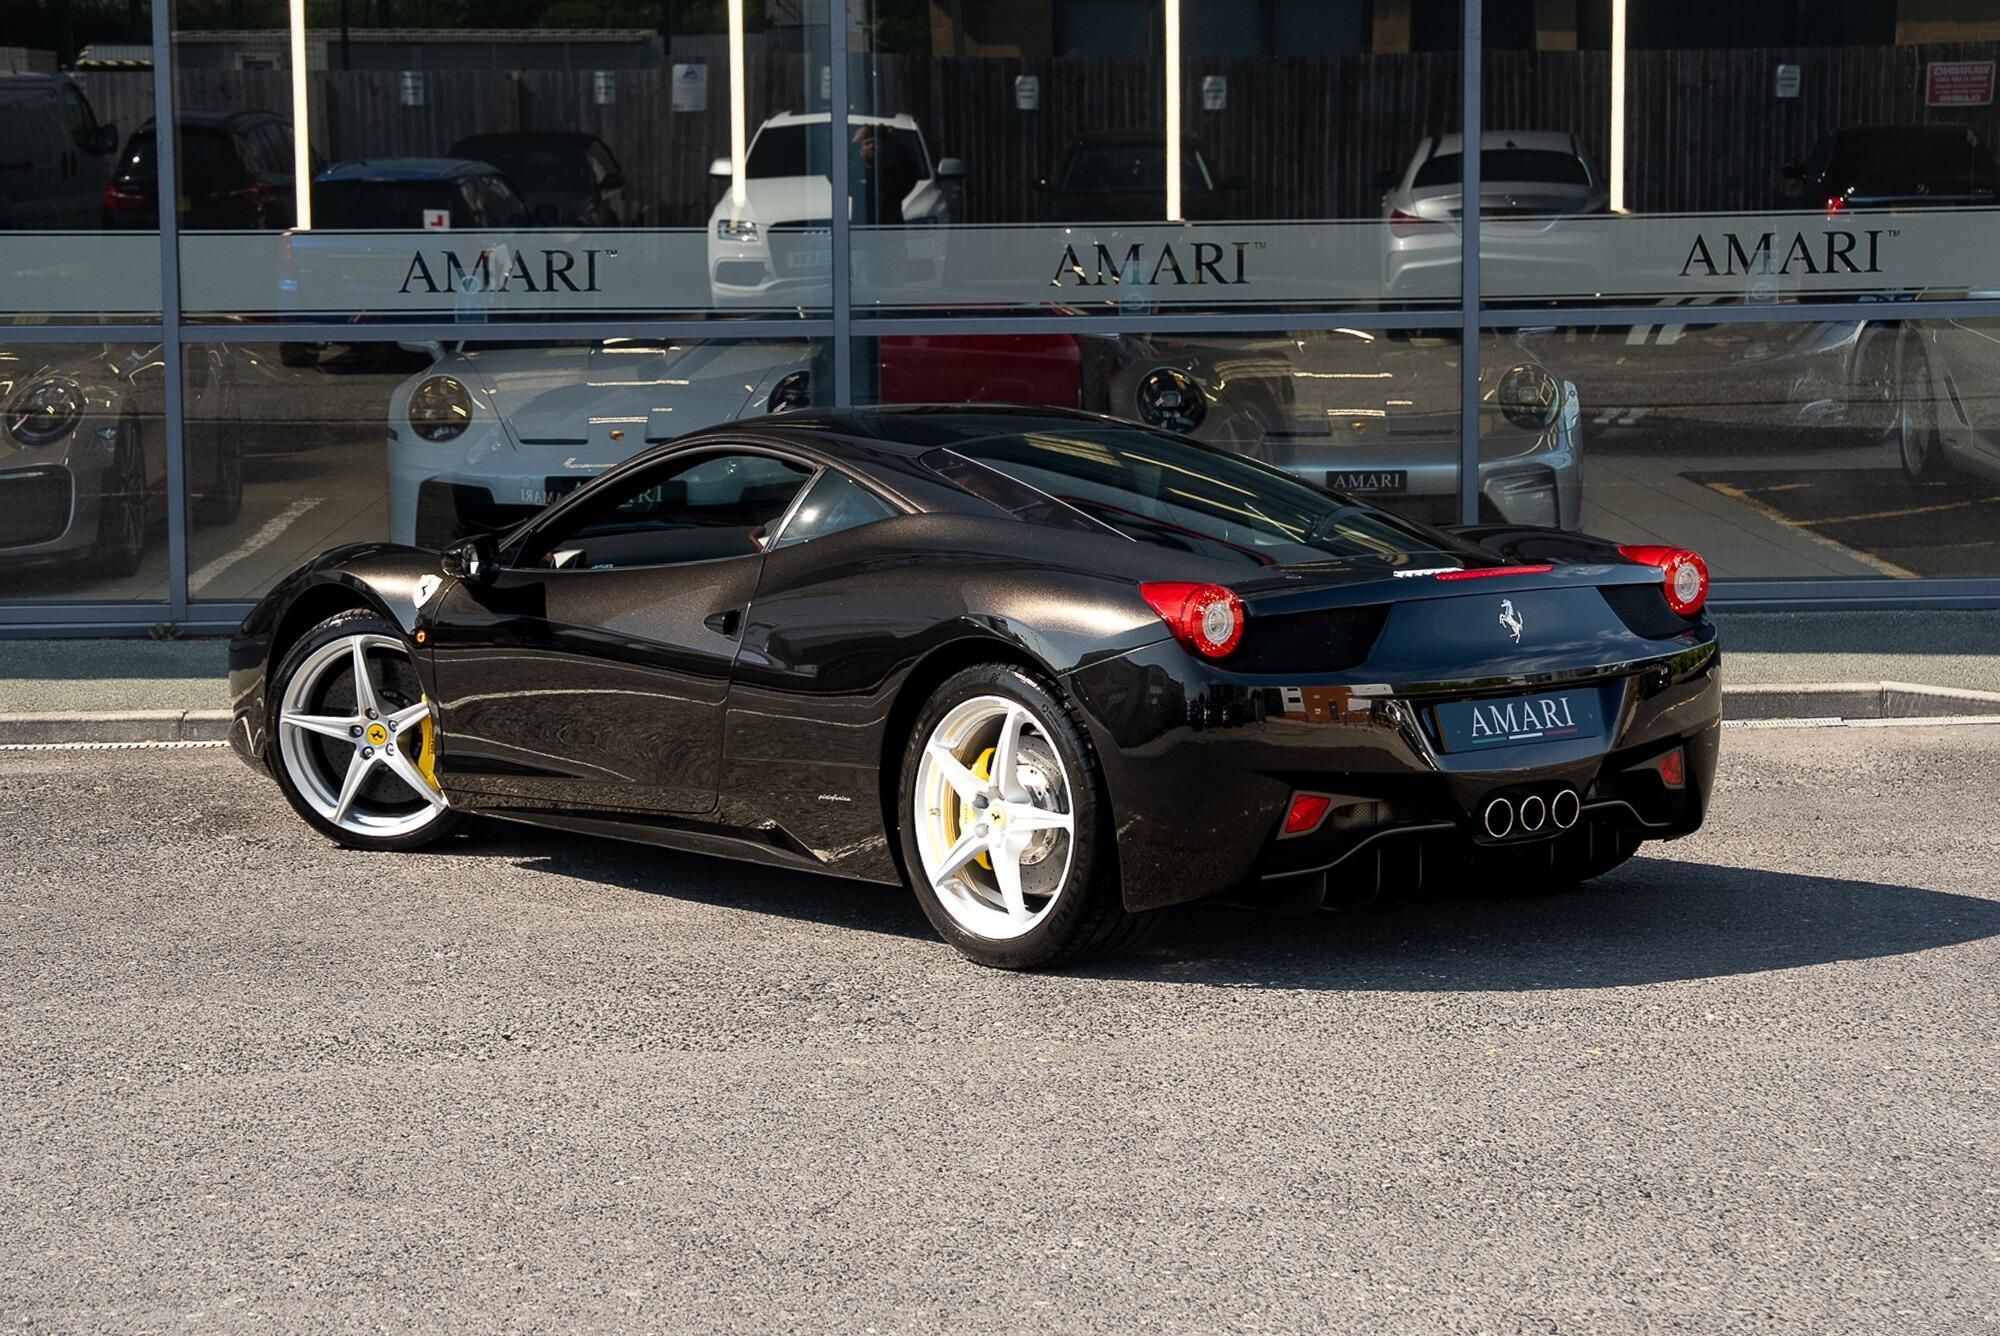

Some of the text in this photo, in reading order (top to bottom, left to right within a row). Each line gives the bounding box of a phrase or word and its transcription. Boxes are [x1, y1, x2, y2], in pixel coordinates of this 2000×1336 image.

[398, 249, 602, 293] AMARI
[1049, 242, 1251, 286] AMARI
[1678, 230, 1884, 276] AMARI
[1334, 473, 1399, 489] AMARI
[1471, 697, 1575, 737] AMARI
